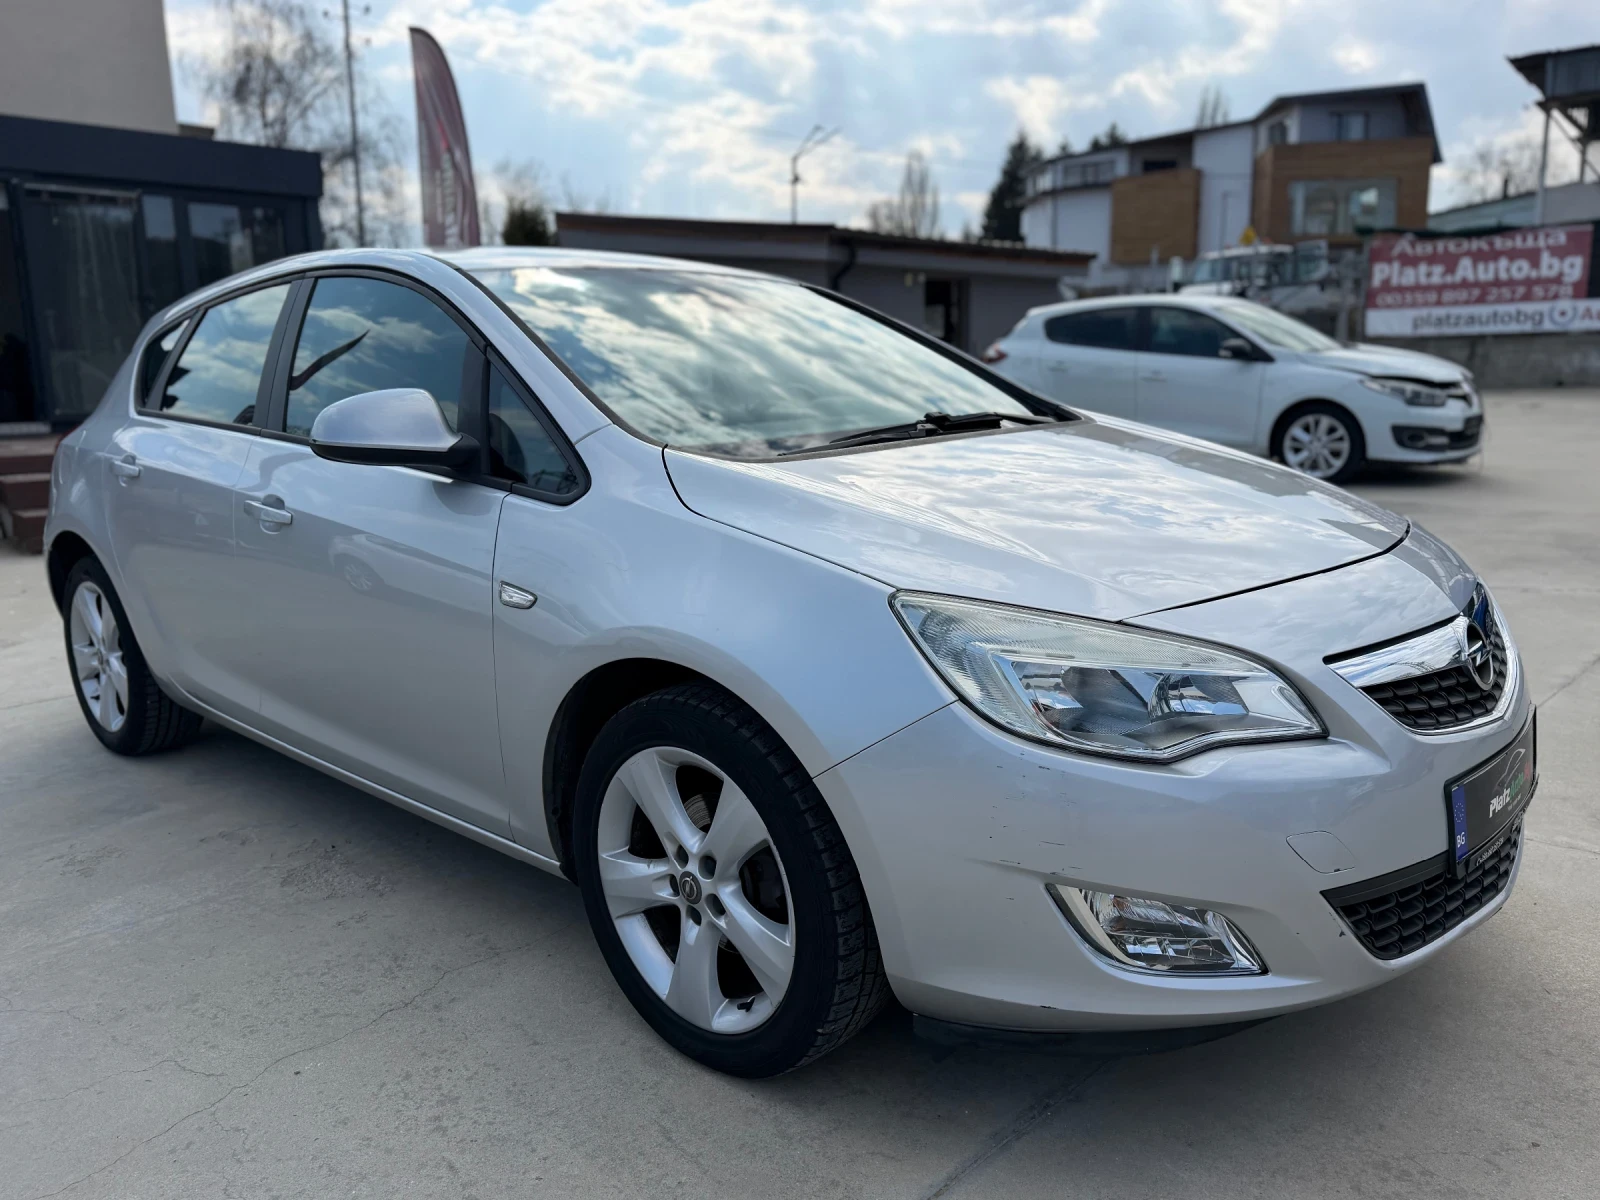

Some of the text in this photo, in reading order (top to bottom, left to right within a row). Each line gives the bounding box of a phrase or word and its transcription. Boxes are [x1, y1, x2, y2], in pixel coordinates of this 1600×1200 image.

[1371, 249, 1583, 288] Platz.Auto.bg
[1411, 308, 1545, 331] platzautobg
[1456, 832, 1466, 848] BG
